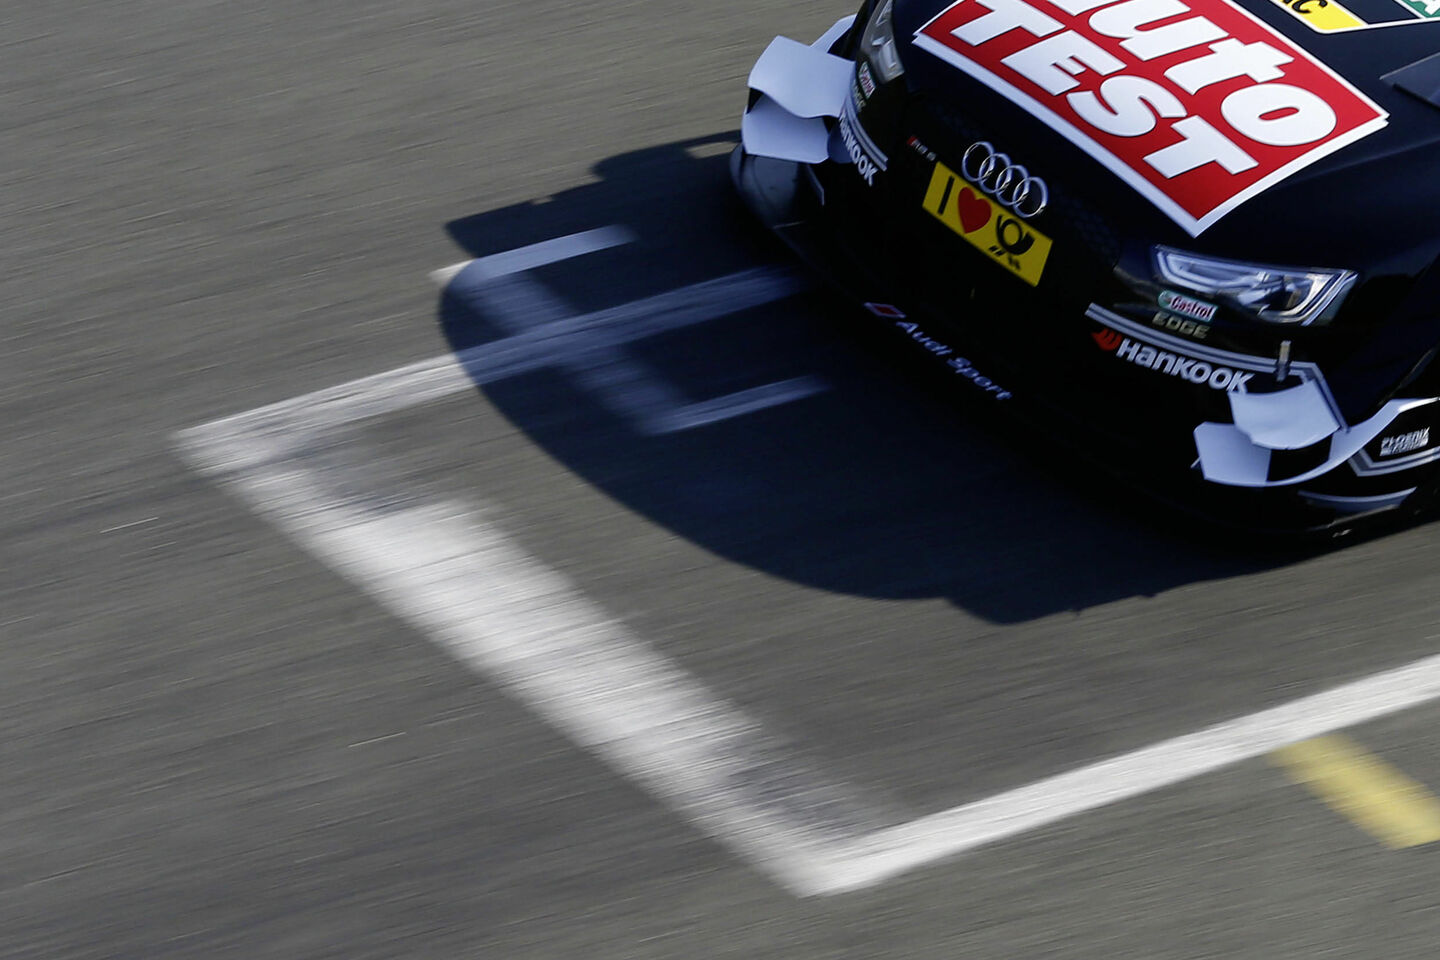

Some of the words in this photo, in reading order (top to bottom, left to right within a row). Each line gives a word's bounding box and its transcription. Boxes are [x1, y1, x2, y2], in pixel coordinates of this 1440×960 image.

[1170, 294, 1215, 319] Castrol
[1152, 311, 1211, 340] EDGE
[896, 321, 953, 356] Audi
[947, 357, 1013, 400] Sport
